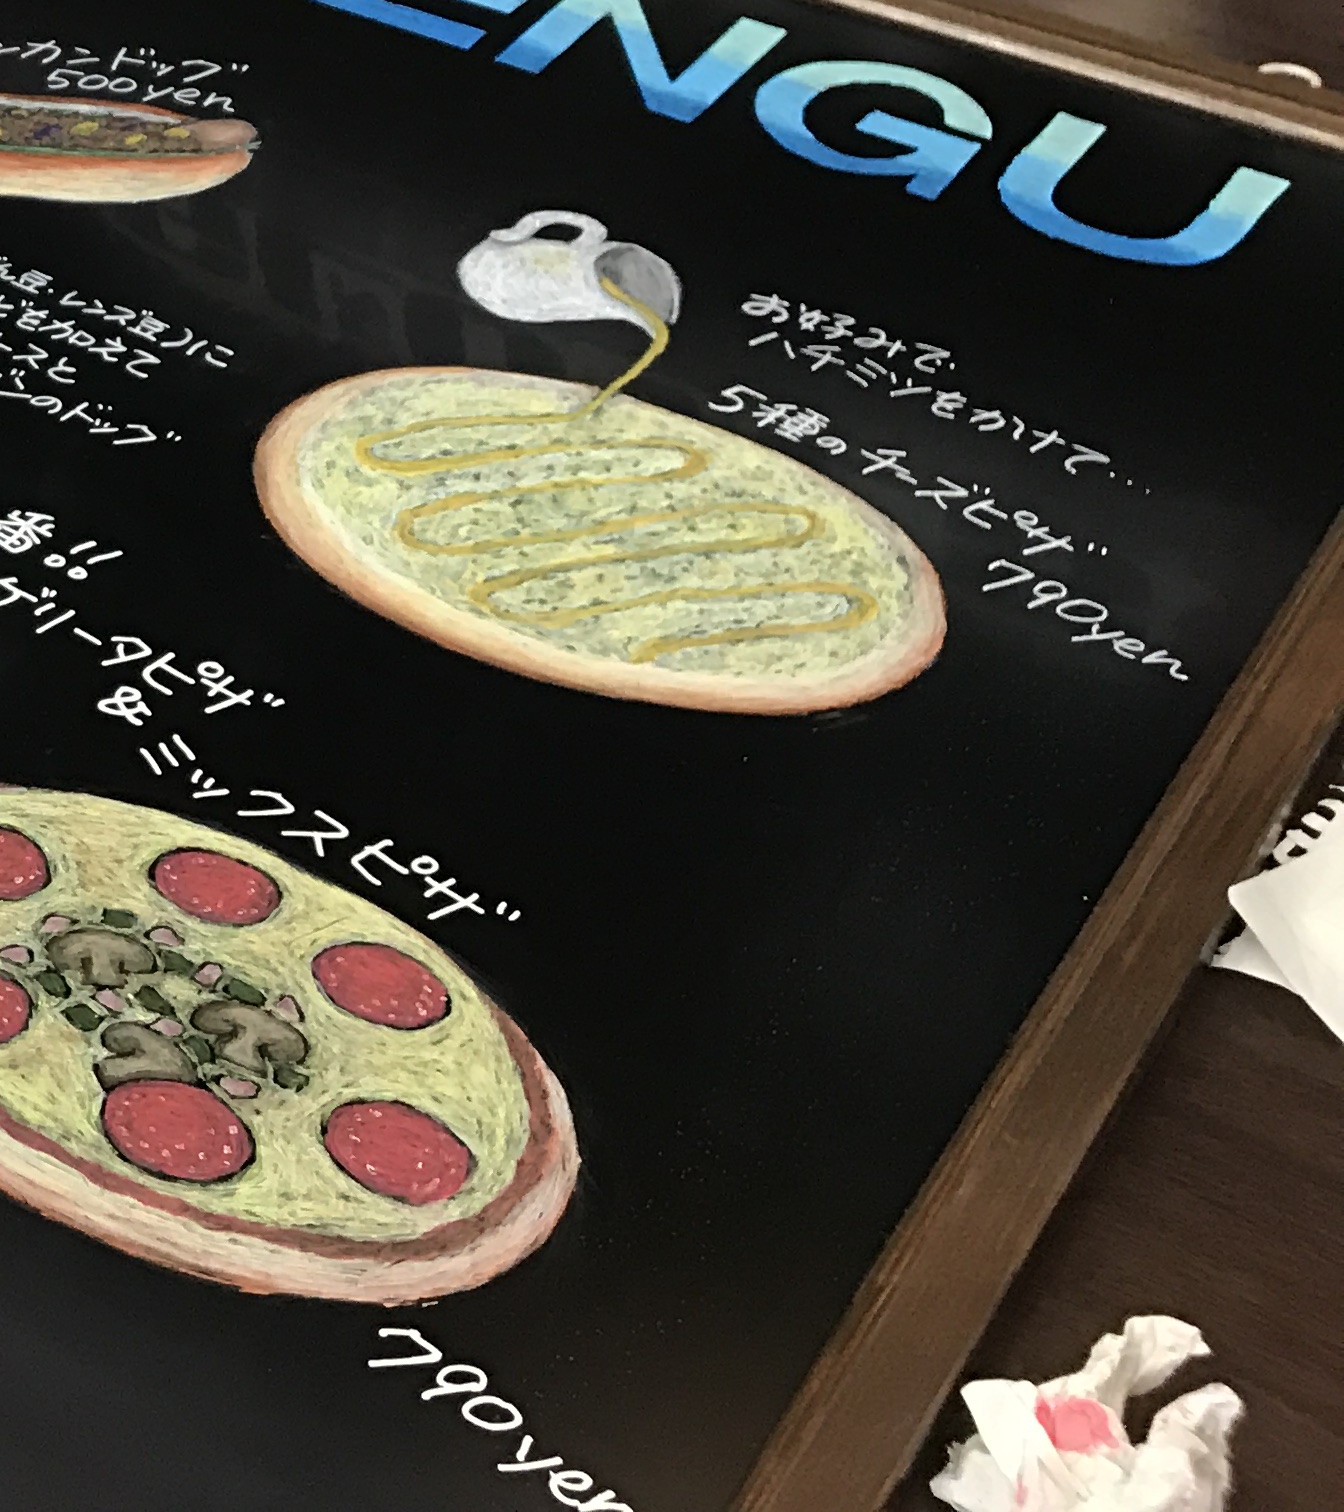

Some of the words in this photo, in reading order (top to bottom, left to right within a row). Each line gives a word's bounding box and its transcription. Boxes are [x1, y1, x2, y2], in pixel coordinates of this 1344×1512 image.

[982, 558, 1189, 681] 790yen
[139, 733, 522, 924] ミックスピザ
